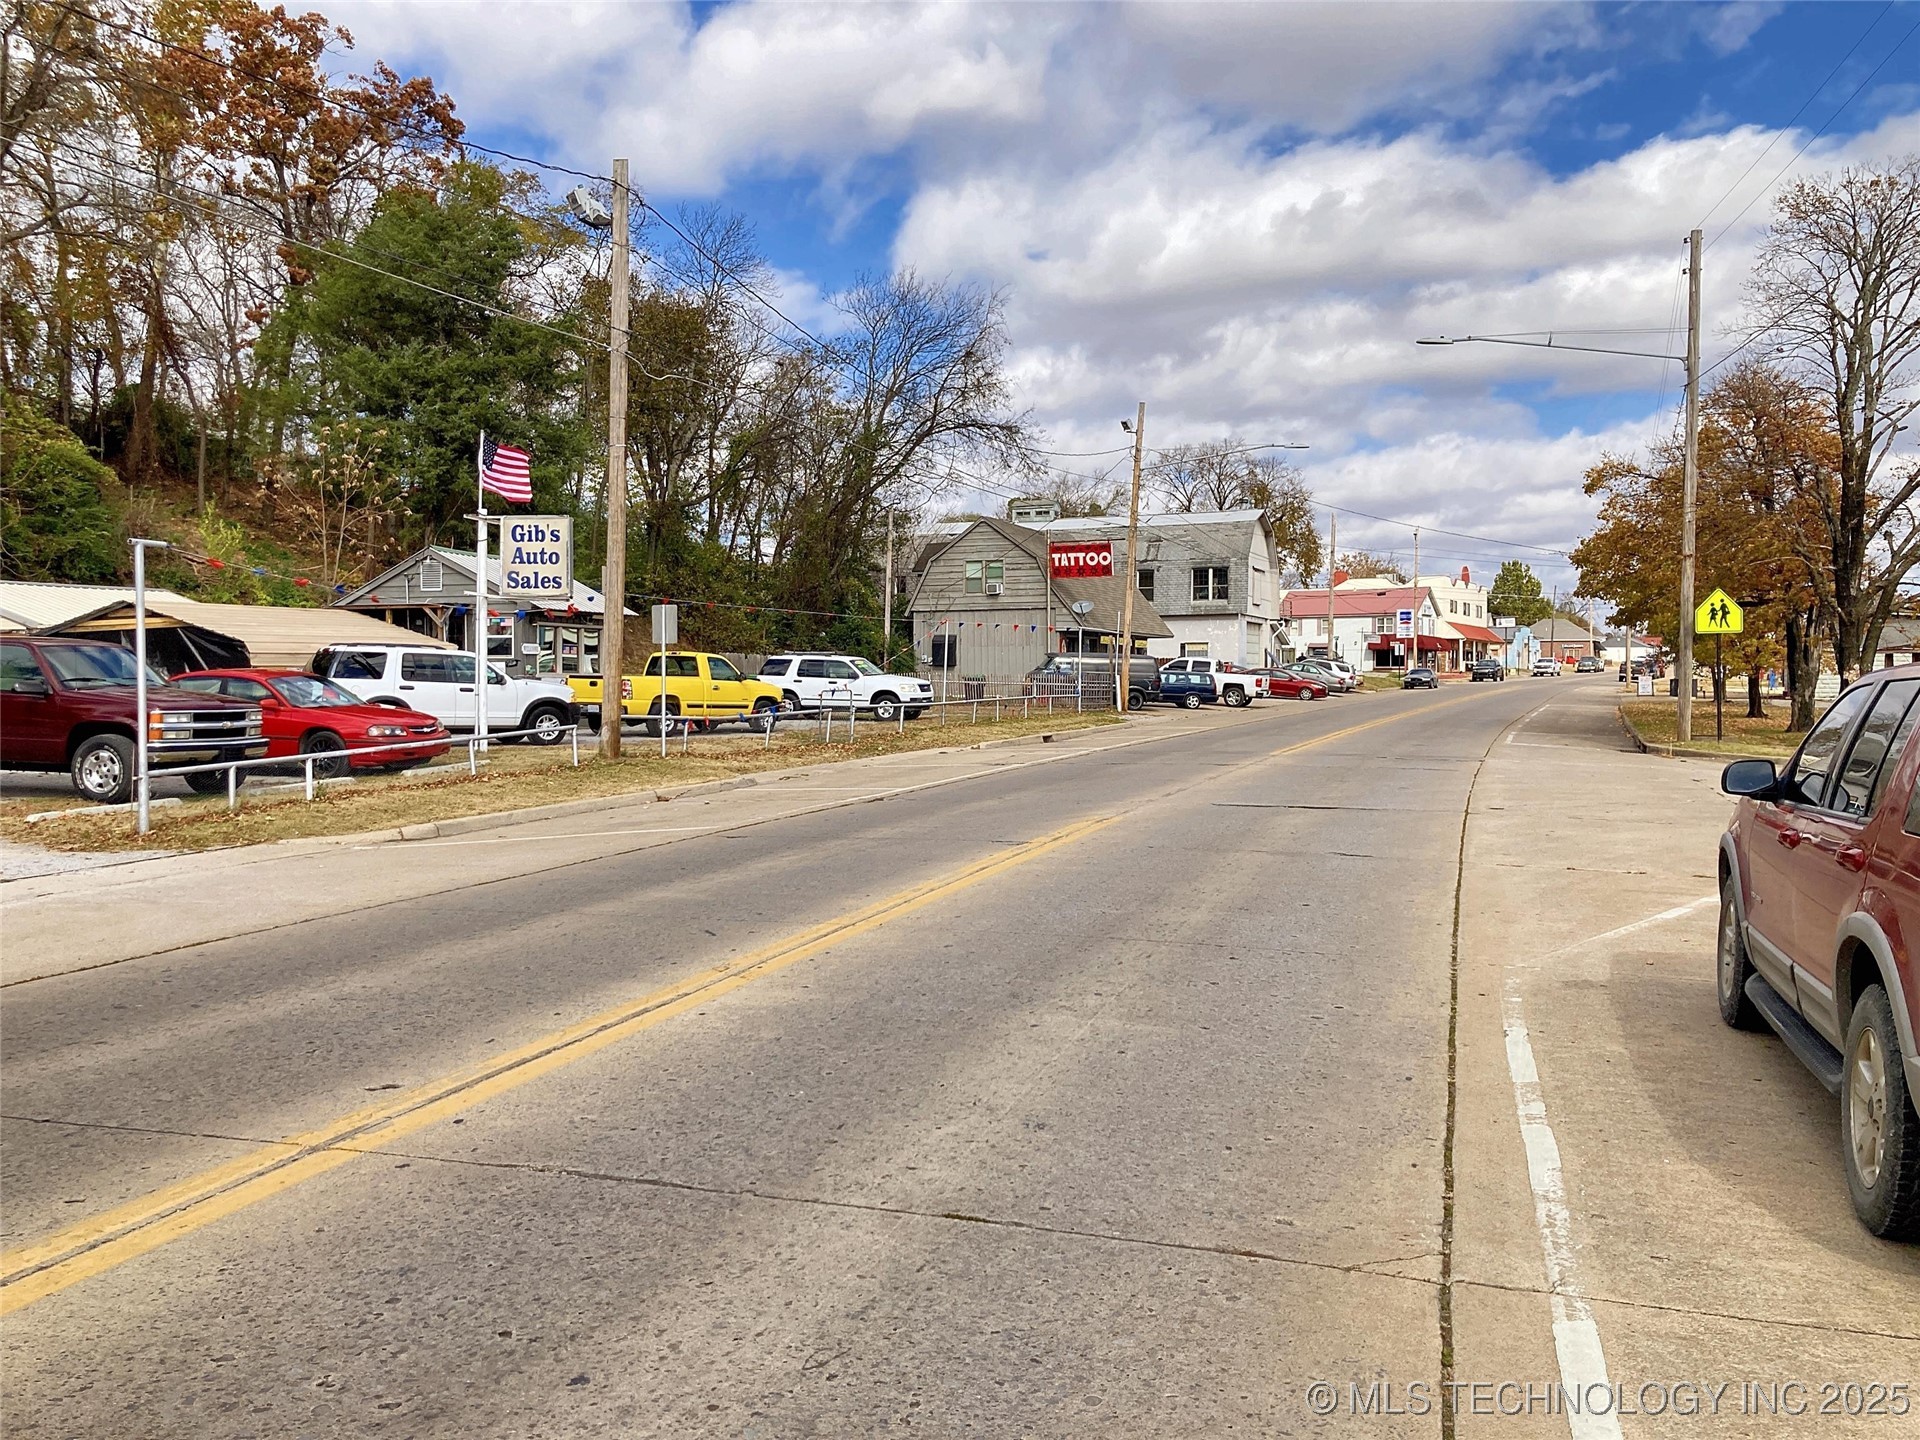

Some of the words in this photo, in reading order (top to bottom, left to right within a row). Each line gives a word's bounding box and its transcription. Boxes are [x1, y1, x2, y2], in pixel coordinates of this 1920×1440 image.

[511, 524, 561, 542] Gib's
[511, 546, 560, 565] Auto
[1051, 551, 1112, 567] TATTOO
[507, 571, 562, 589] Sales
